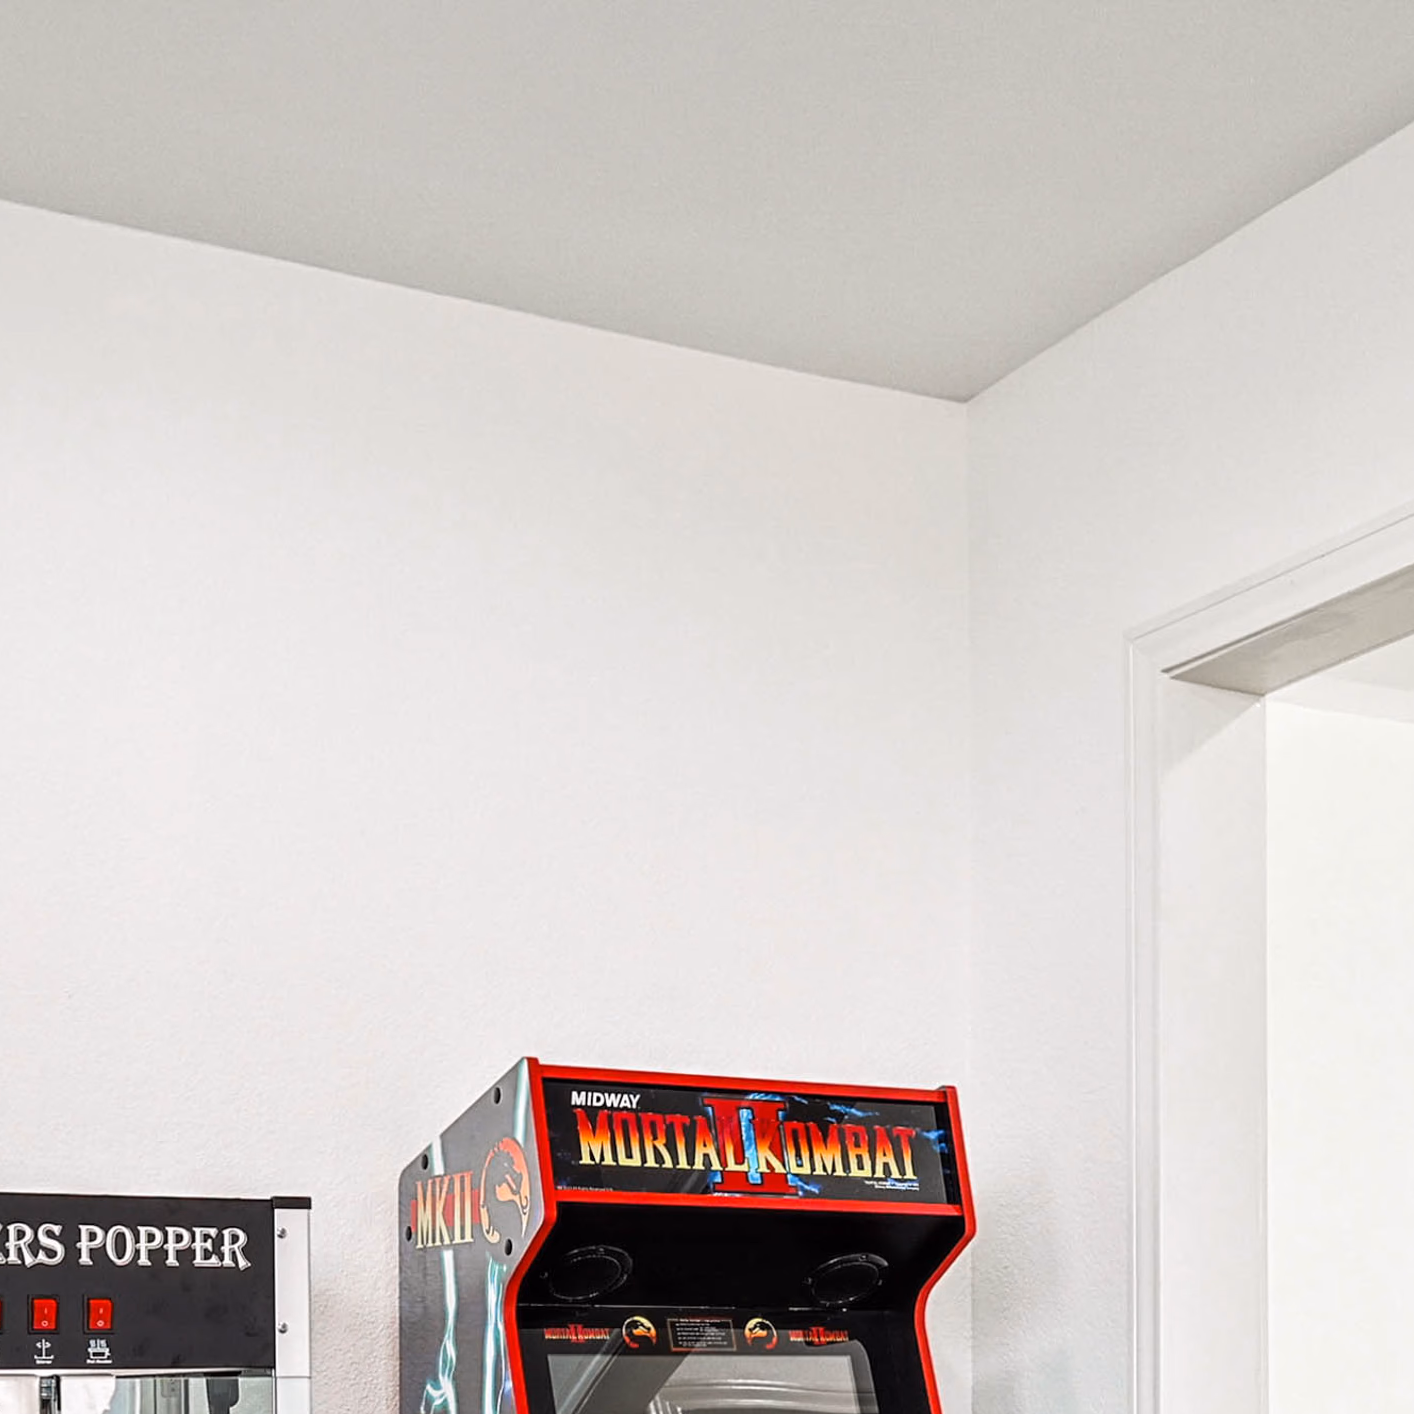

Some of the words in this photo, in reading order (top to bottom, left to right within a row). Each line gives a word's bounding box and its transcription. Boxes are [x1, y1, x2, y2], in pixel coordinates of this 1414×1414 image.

[571, 1091, 640, 1109] MIDWAY
[573, 1107, 751, 1173] MORTAL
[753, 1118, 919, 1181] KOMBAT
[415, 1171, 473, 1250] MKII
[76, 1222, 251, 1271] POPPER
